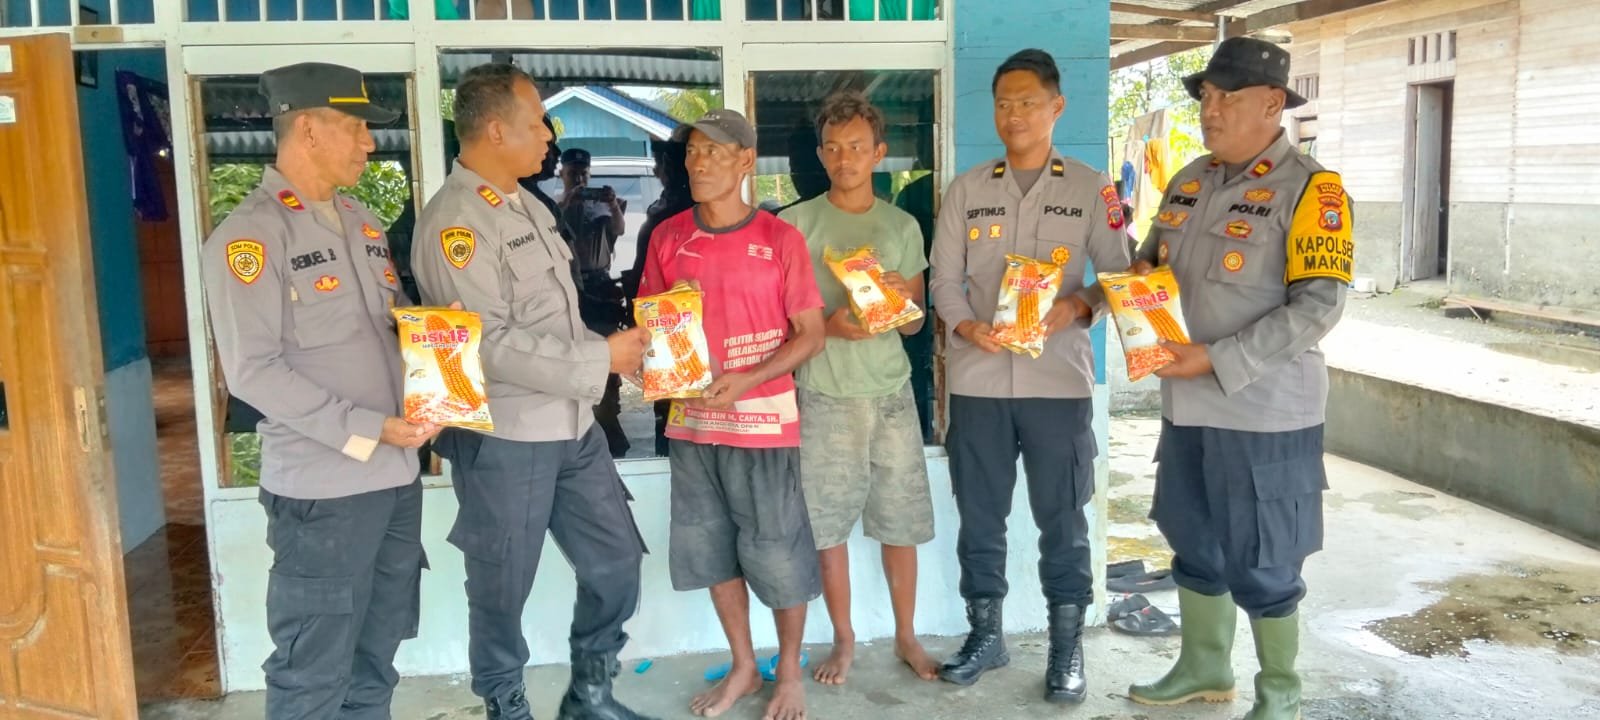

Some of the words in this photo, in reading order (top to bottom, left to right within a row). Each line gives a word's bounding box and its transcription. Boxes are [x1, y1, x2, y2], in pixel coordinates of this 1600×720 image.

[966, 207, 1006, 219] SEPTINUS
[1044, 205, 1083, 218] POLRI
[1228, 203, 1273, 217] POLRI
[723, 333, 754, 348] POLITIK
